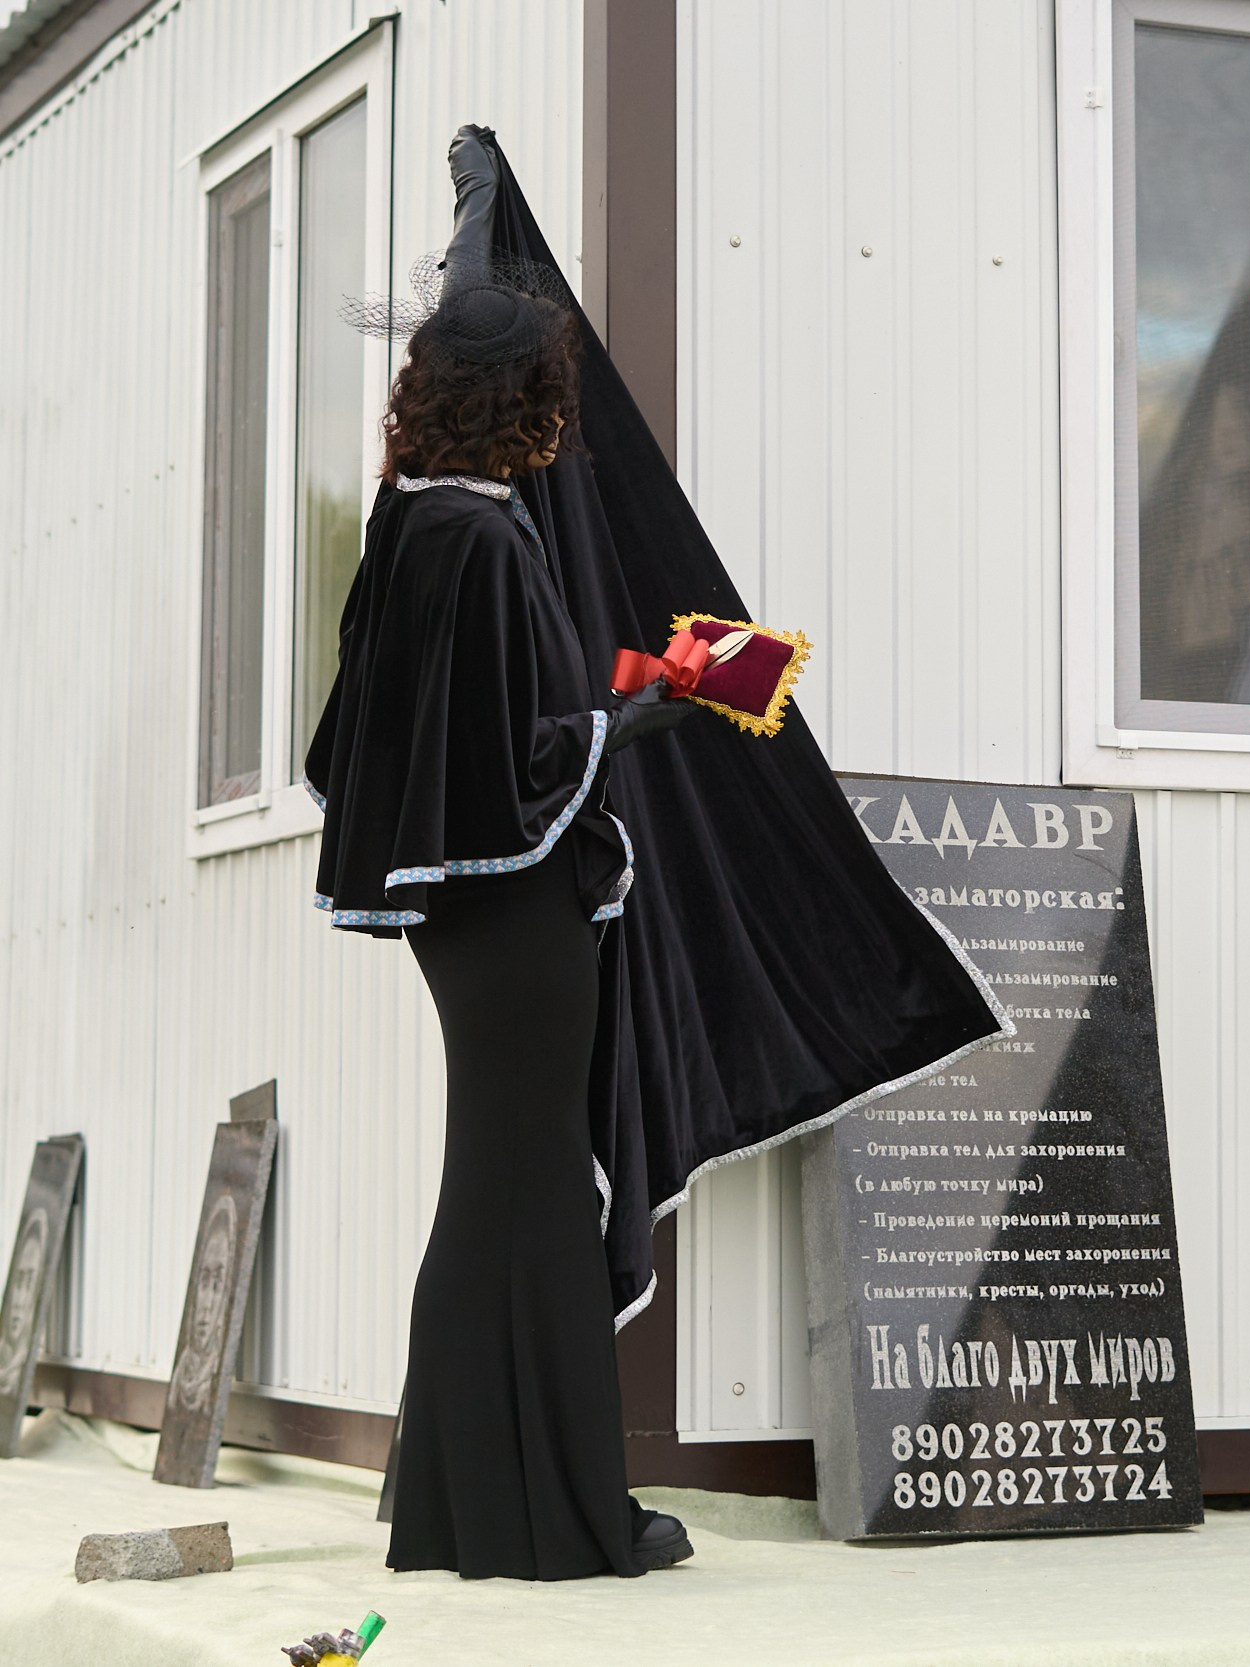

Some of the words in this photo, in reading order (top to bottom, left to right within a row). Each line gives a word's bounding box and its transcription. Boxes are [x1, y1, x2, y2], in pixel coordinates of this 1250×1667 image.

[1056, 1007, 1092, 1020] тела
[950, 1074, 979, 1088] тел
[863, 1106, 947, 1126] Отправка
[950, 1108, 979, 1122] тел
[983, 1110, 1004, 1122] на
[1008, 1109, 1093, 1126] кремацию
[866, 1141, 950, 1161] Отправка
[953, 1144, 982, 1157] тел
[985, 1144, 1016, 1160] для
[1020, 1144, 1126, 1161] захоронения
[879, 1177, 937, 1196] любую
[941, 1180, 991, 1196] точку
[996, 1173, 1044, 1196] мира)
[873, 1212, 975, 1230] Проведение
[980, 1211, 1072, 1231] церемоний
[1076, 1213, 1161, 1230] прощания
[876, 1248, 1020, 1267] Благоустройство
[1024, 1248, 1061, 1263] мест
[1066, 1248, 1171, 1264] захоронения
[863, 1281, 973, 1302] (памятники,
[979, 1286, 1045, 1302] кресты,
[1049, 1283, 1115, 1301] оргады,
[1119, 1277, 1166, 1299] уход)
[866, 1324, 912, 1390] На
[916, 1323, 1000, 1389] благо
[1008, 1331, 1082, 1405] двух
[891, 1416, 1168, 1462] 89028273725
[893, 1459, 1174, 1510] 89028273724
